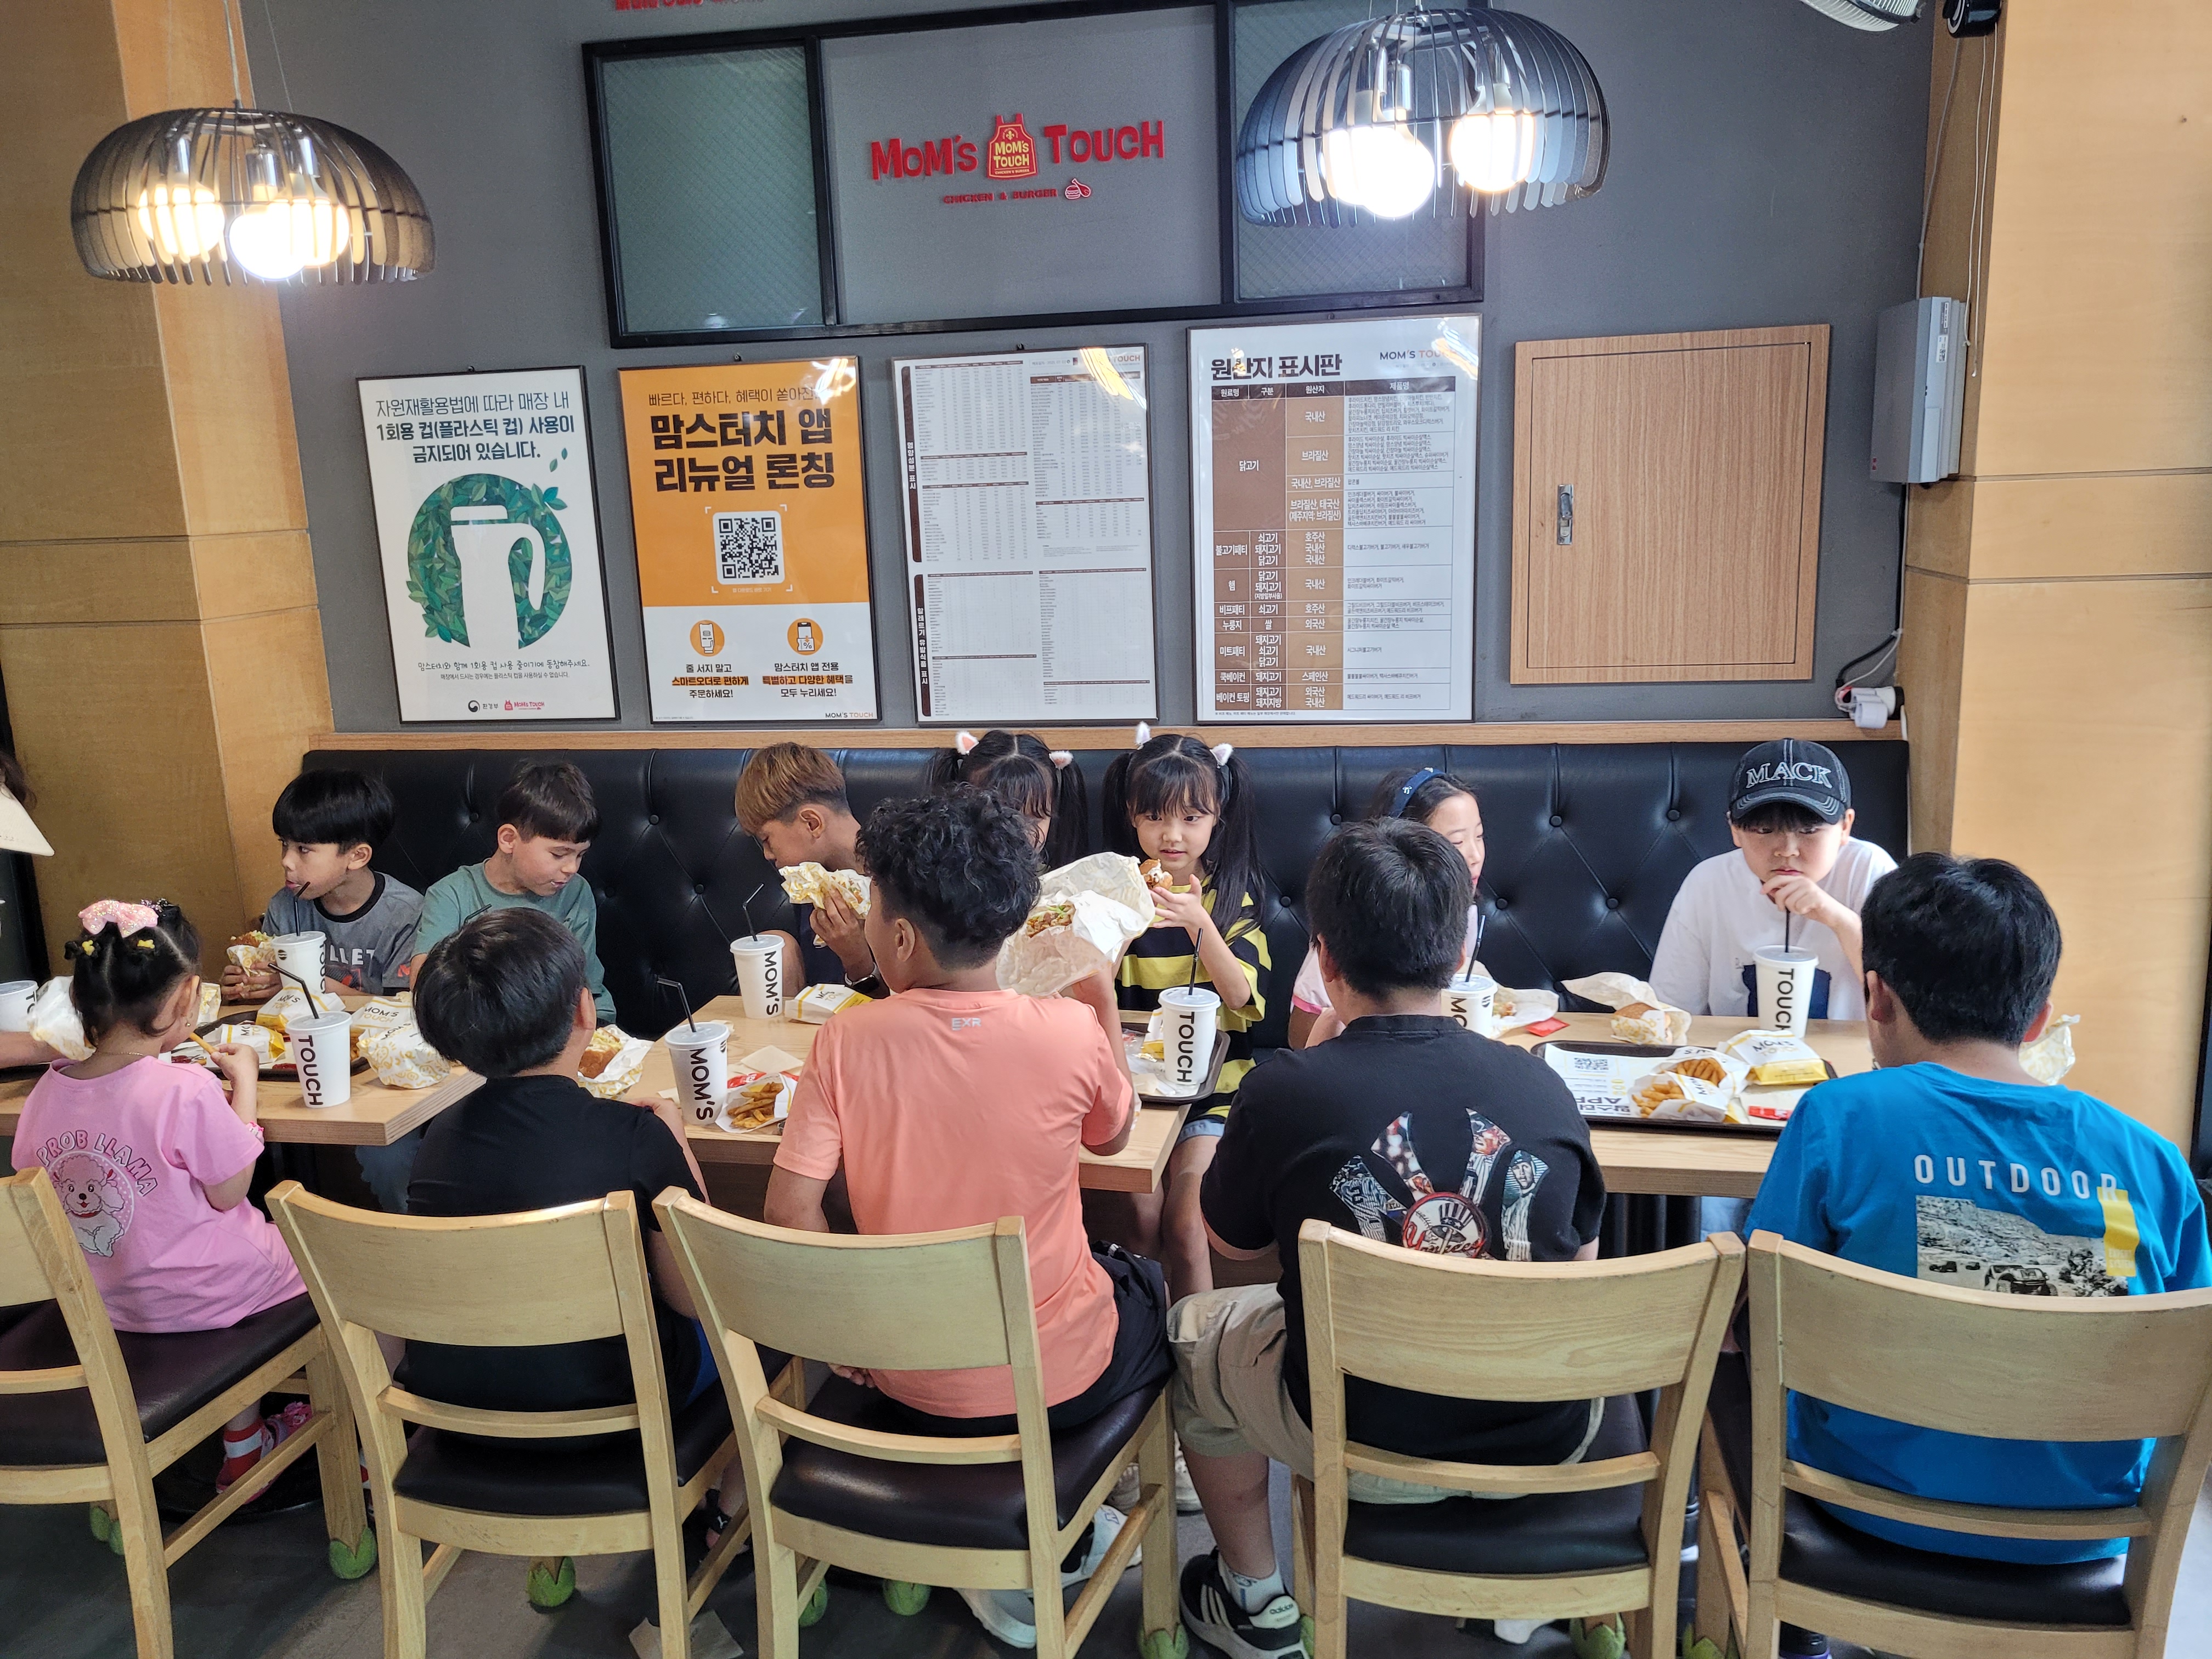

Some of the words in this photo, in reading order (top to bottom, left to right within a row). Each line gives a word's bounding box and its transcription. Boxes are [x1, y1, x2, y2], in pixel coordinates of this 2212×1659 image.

[994, 154, 1029, 168] TOUCH
[943, 193, 994, 205] CHICKEN
[1000, 191, 1008, 200] &
[1012, 189, 1058, 199] BURGER
[1380, 350, 1415, 360] MOM'S
[1278, 353, 1342, 378] 표시판
[1220, 388, 1239, 397] 원료명
[1261, 387, 1273, 396] 구분
[1305, 385, 1324, 394] 원산지
[1389, 381, 1409, 390] 제품명
[648, 393, 687, 407] 빠르다,
[692, 391, 731, 405] 편하다,
[736, 389, 772, 403] 혜택이
[776, 387, 820, 402] 쏟아진
[376, 396, 479, 417] 자원재활용법에
[483, 394, 514, 412] 따라
[518, 392, 548, 410] 매장
[554, 391, 569, 409] 내
[1305, 411, 1325, 422] 국내산
[376, 422, 414, 441] 1회용
[419, 419, 498, 439] 컵(플라스틱
[503, 417, 523, 436] 컵)
[529, 415, 574, 434] 사용이
[651, 410, 786, 450] 맘스터치
[799, 408, 832, 445] 앱
[413, 444, 471, 463] 금지되어
[476, 441, 541, 461] 있습니다.
[906, 442, 915, 472] 영양성분
[1302, 450, 1329, 461] 브라질산
[1239, 460, 1259, 472] 닭고기
[654, 455, 755, 493] 리뉴얼
[766, 452, 834, 489] 론칭
[909, 475, 916, 490] 표시
[1291, 478, 1313, 489] 국내산,
[1314, 477, 1341, 488] 브라질산
[1290, 499, 1318, 510] 브라질산,
[1319, 498, 1340, 510] 태국산
[1289, 510, 1315, 522] (제주지역:
[1316, 510, 1341, 521] 브라질산)
[1258, 533, 1278, 543] 쇠고기
[1305, 532, 1325, 543] 호주산
[1215, 544, 1248, 556] 불고기패티
[1255, 543, 1281, 555] 돼지고기
[1305, 543, 1325, 554] 국내산
[1259, 555, 1278, 566] 닭고기
[1305, 554, 1325, 565] 국내산
[1259, 571, 1278, 582] 닭고기
[1228, 580, 1235, 591] 햄
[1255, 582, 1282, 593] 돼지고기
[1305, 579, 1325, 590] 국내산
[1254, 592, 1282, 600] (지방일부사용)
[1220, 605, 1245, 616] 비프패티
[1259, 604, 1278, 616] 쇠고기
[1305, 603, 1325, 614] 호주산
[917, 607, 925, 636] 알레르기
[1222, 620, 1242, 630] 누룽지
[1265, 619, 1272, 630] 쌀
[1305, 618, 1325, 629] 외국산
[1255, 634, 1282, 646] 돼지고기
[919, 639, 927, 668] 유발식품
[1220, 646, 1245, 657] 미트패티
[1259, 646, 1278, 657] 쇠고기
[1306, 645, 1326, 656] 국내산
[418, 662, 451, 671] 맘스터치와
[454, 662, 467, 670] 함께
[471, 661, 487, 669] 1회용
[490, 661, 497, 670] 컵
[500, 661, 514, 669] 사용
[517, 660, 544, 670] 줄이기에
[546, 659, 590, 669] 동참해주세요.
[774, 662, 808, 672] 맘스터치
[811, 662, 819, 672] 앱
[822, 662, 839, 672] 전용
[1259, 657, 1278, 668] 닭고기
[686, 664, 694, 673] 줄
[697, 664, 713, 673] 서지
[715, 664, 732, 673] 말고
[672, 676, 721, 686] 스마트오더로
[724, 676, 748, 686] 편하게
[762, 675, 797, 685] 특별하고
[799, 675, 824, 685] 다양한
[826, 675, 853, 684] 혜택을
[921, 671, 928, 685] 표시
[1220, 672, 1245, 683] 쿡베이컨
[1255, 672, 1282, 683] 돼지고기
[1302, 671, 1328, 682] 스페인산
[689, 689, 733, 698] 주문하세요!
[781, 689, 798, 698] 모두
[800, 688, 837, 698] 누리세요!
[1216, 691, 1235, 703] 베이컨
[1236, 691, 1250, 703] 토핑
[1256, 686, 1282, 697] 돼지고기
[1305, 686, 1325, 697] 외국산
[1256, 697, 1282, 708] 돼지지방
[1305, 697, 1325, 708] 국내산
[1746, 761, 1833, 788] MACK
[764, 950, 779, 1015] MOM'S
[951, 1016, 982, 1031] EXR
[1177, 1012, 1195, 1082] TOUCH
[298, 1035, 324, 1105] TOUCH
[690, 1047, 715, 1120] MOM'S
[36, 1130, 88, 1167] PROB
[94, 1132, 159, 1198] LLAMA
[1914, 1154, 2119, 1201] OUTDOOR
